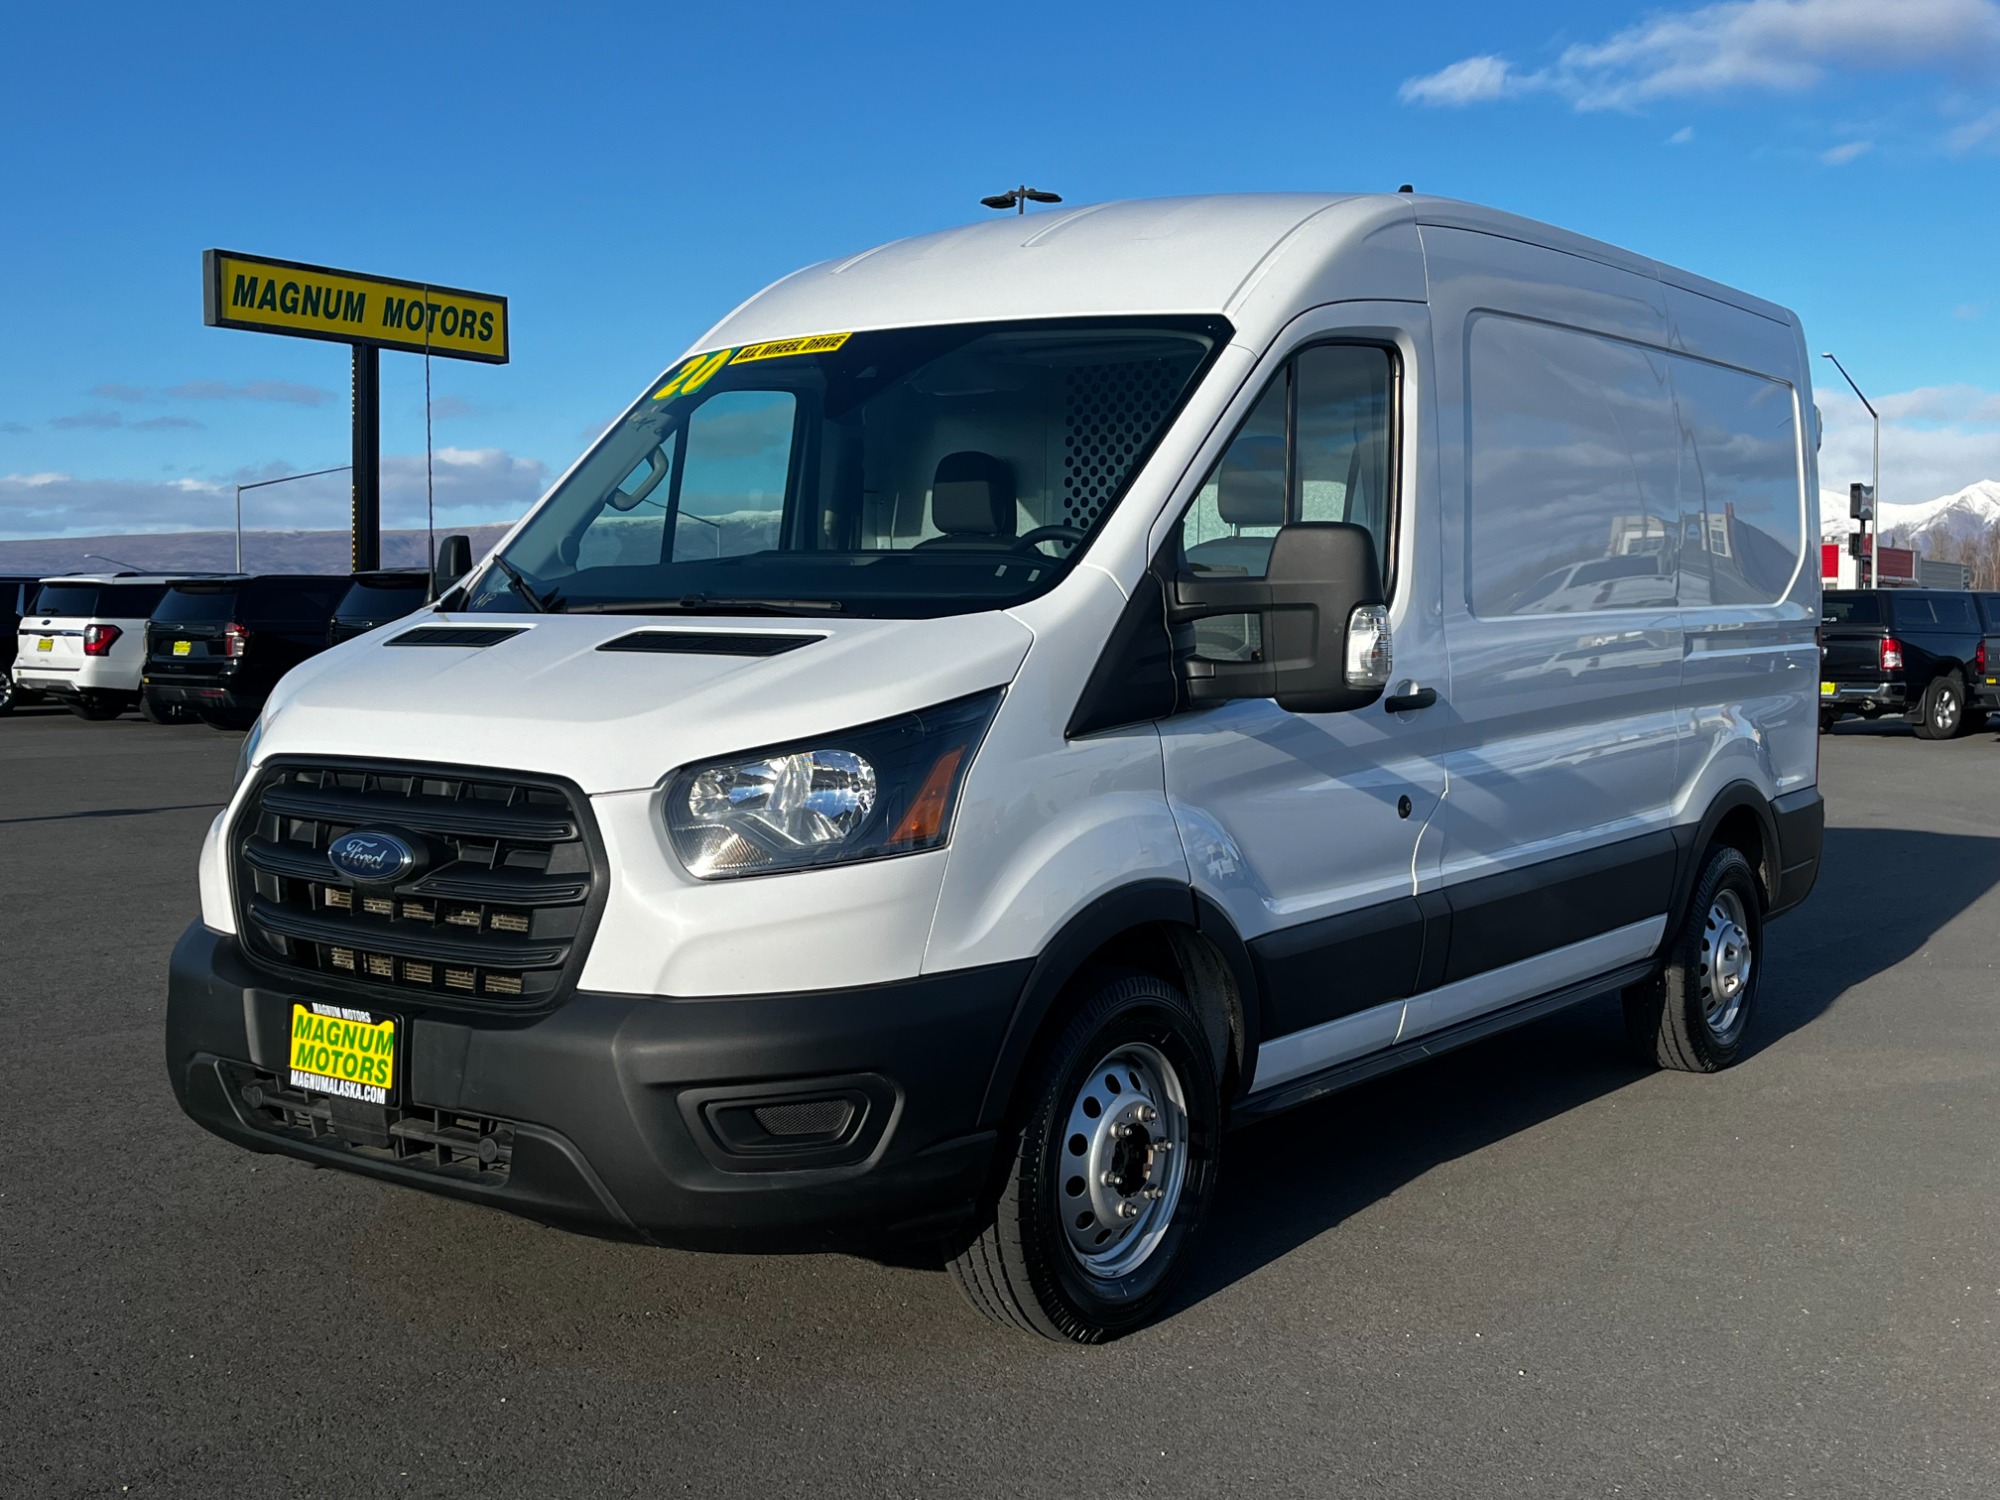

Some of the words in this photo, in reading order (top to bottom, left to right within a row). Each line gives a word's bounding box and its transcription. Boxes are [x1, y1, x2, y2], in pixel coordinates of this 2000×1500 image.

[232, 274, 366, 324] MAGNUM
[382, 297, 494, 342] MOTORS
[735, 345, 763, 362] ALL
[758, 339, 804, 357] WHEEL
[800, 335, 848, 351] DRIVE
[653, 349, 732, 400] 20
[341, 839, 388, 870] Ford
[311, 1002, 342, 1019] MAGNUM
[341, 1007, 371, 1024] MOTORS
[294, 1014, 394, 1057] MAGNUM
[295, 1042, 389, 1085] MOTORS
[290, 1069, 386, 1105] MAGNUMALASKA.COM
